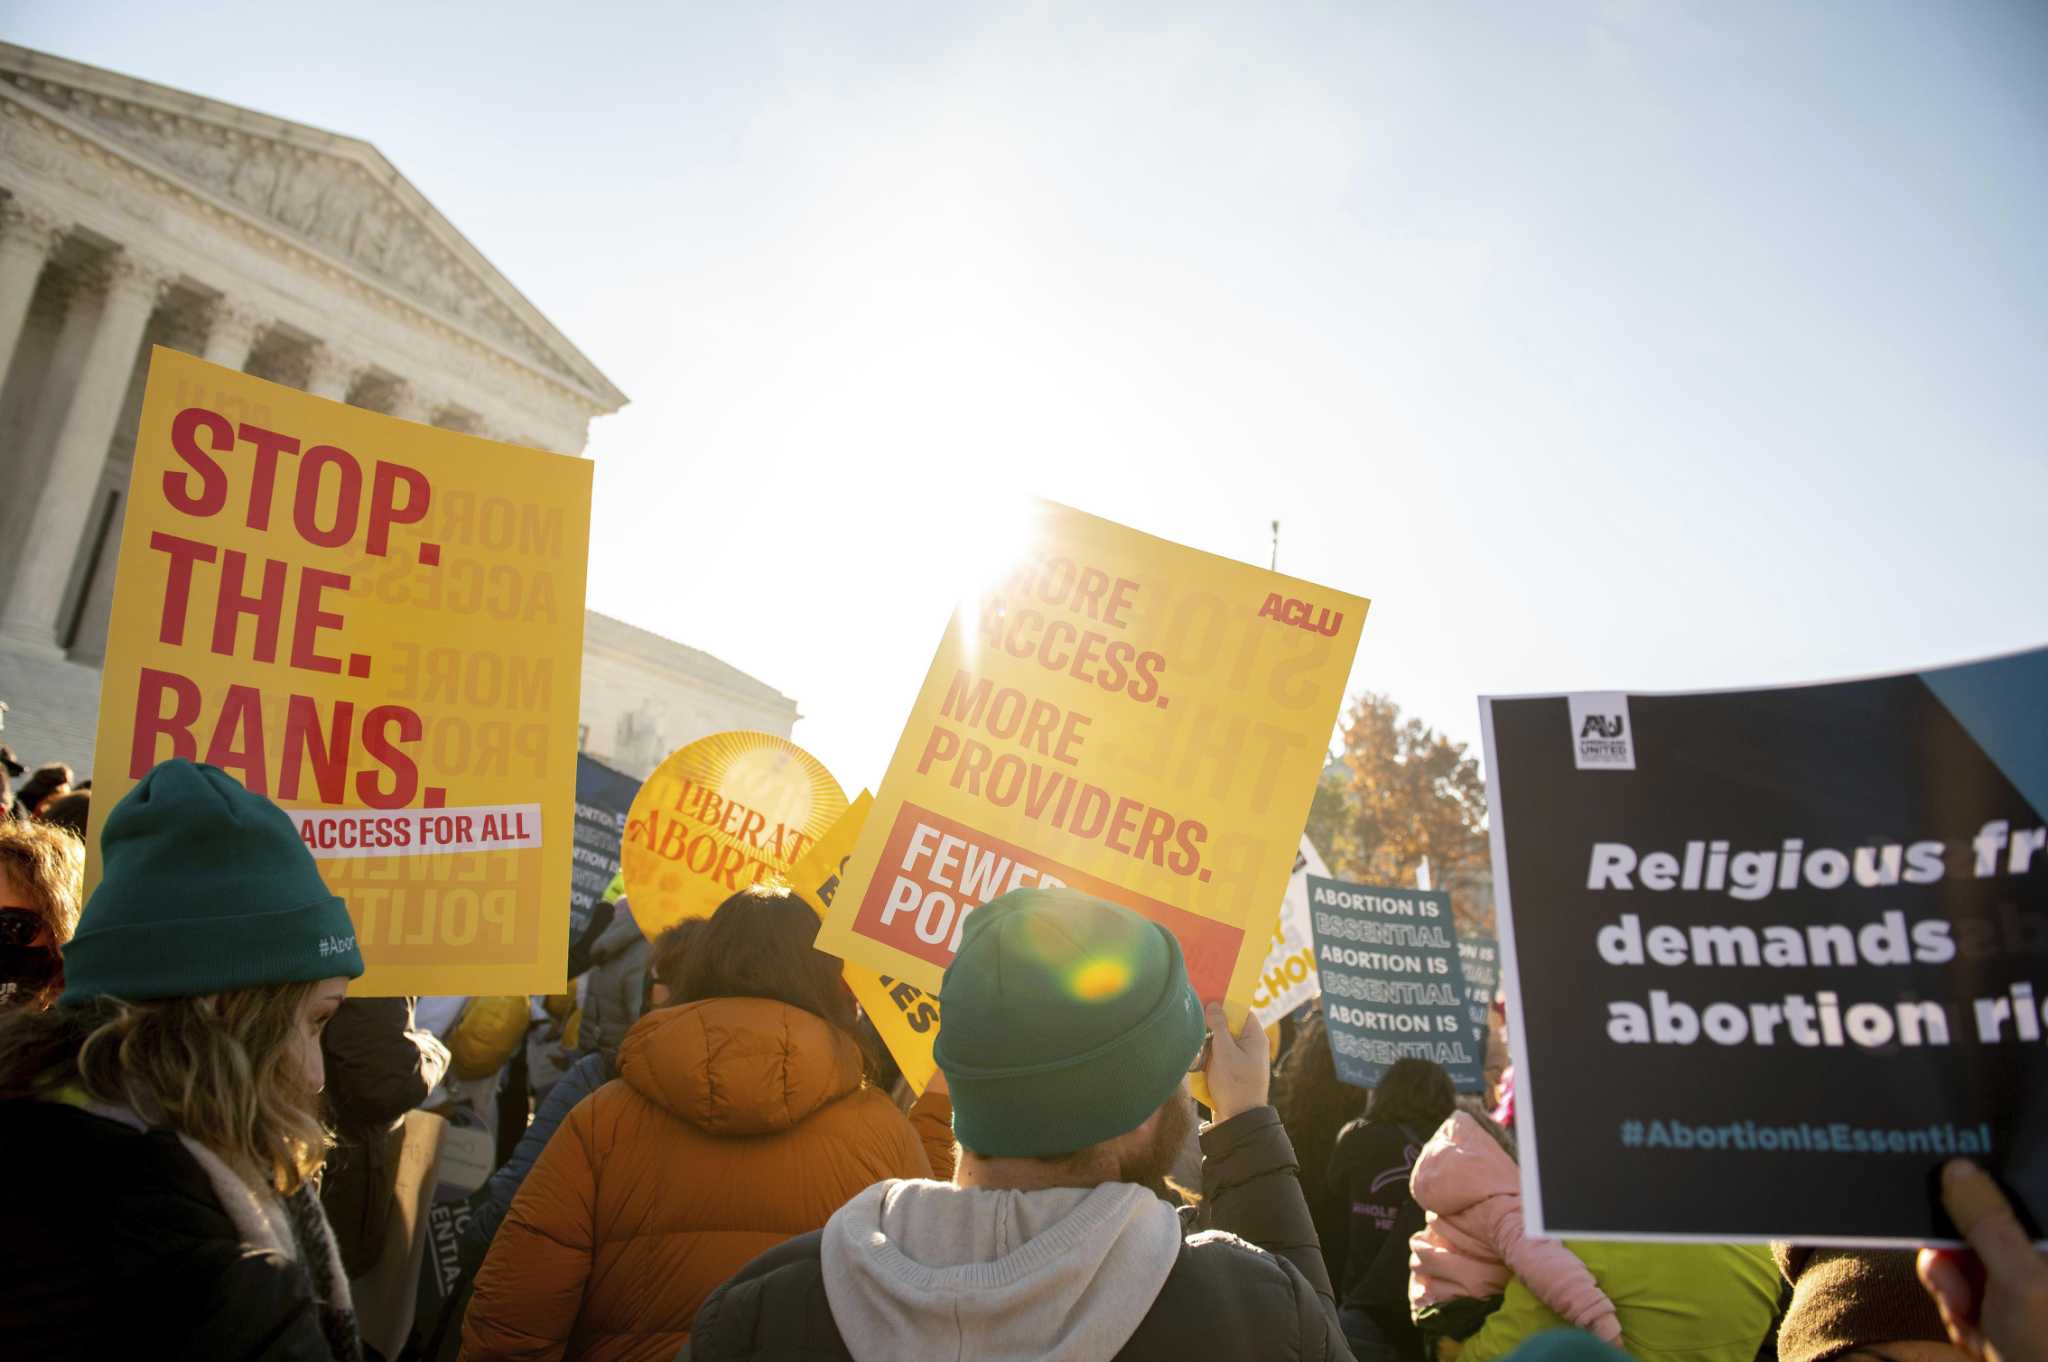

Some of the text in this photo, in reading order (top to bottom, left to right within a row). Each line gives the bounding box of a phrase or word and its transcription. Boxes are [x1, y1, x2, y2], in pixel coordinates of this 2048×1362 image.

[162, 407, 441, 566] STOP.
[149, 530, 372, 679] THE.
[1258, 592, 1344, 637] ACLU
[128, 667, 447, 810] BANS.
[940, 668, 1093, 767] MORE
[301, 812, 530, 850] ACCESS FOR ALL
[674, 778, 815, 865] LIBERAT
[916, 726, 1216, 883] PROVIDERS.
[629, 809, 786, 891] ABORT
[901, 822, 1067, 904] FEW
[1587, 819, 2048, 901] Religious fr
[1313, 887, 1439, 917] ABORTION IS
[1315, 912, 1451, 949] ESSENTIAL
[1320, 944, 1422, 973] ABORTION
[1427, 956, 1449, 974] IS
[1597, 910, 1956, 967] demands
[1321, 970, 1462, 1006] ESSENTIAL
[1606, 982, 2048, 1046] abortion ri
[1328, 1004, 1430, 1032] ABORTION
[1436, 1014, 1458, 1033] IS
[1331, 1029, 1472, 1065] ESSENTIAL
[1620, 1119, 1992, 1153] #AbortionIsEssential
